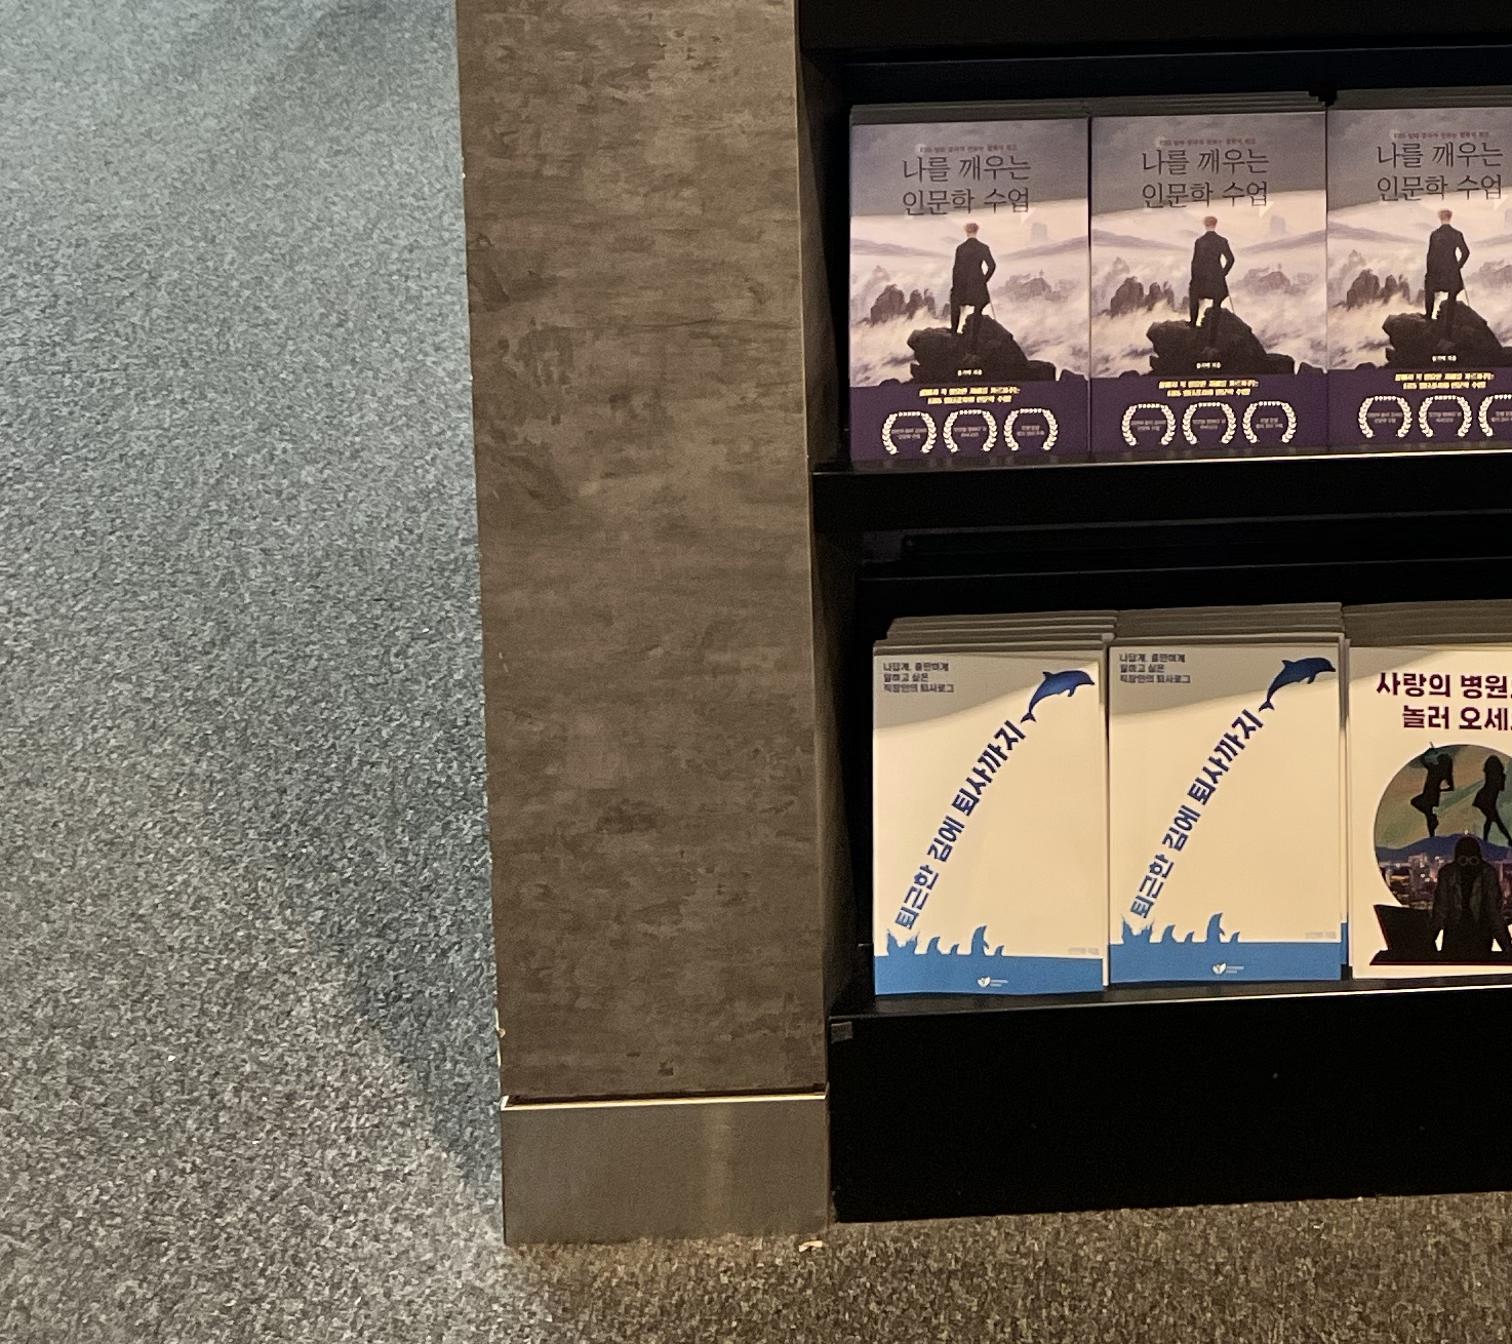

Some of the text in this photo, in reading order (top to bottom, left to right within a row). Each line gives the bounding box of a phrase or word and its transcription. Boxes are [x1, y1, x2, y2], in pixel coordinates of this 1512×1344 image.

[902, 155, 1031, 182] 나를 깨우는
[1143, 149, 1269, 175] 나를 깨우는
[1377, 142, 1503, 168] 나를 깨우는
[901, 188, 1031, 217] 인문학 수업
[1141, 181, 1269, 210] 인문학 수업
[1376, 174, 1502, 203] 인문학 수업
[1377, 673, 1450, 697] 사랑의
[1403, 705, 1449, 729] 놀러
[894, 719, 1026, 930] 퇴근한 김에 퇴사까지
[1130, 708, 1264, 918] 퇴근한 김에 퇴사까지
